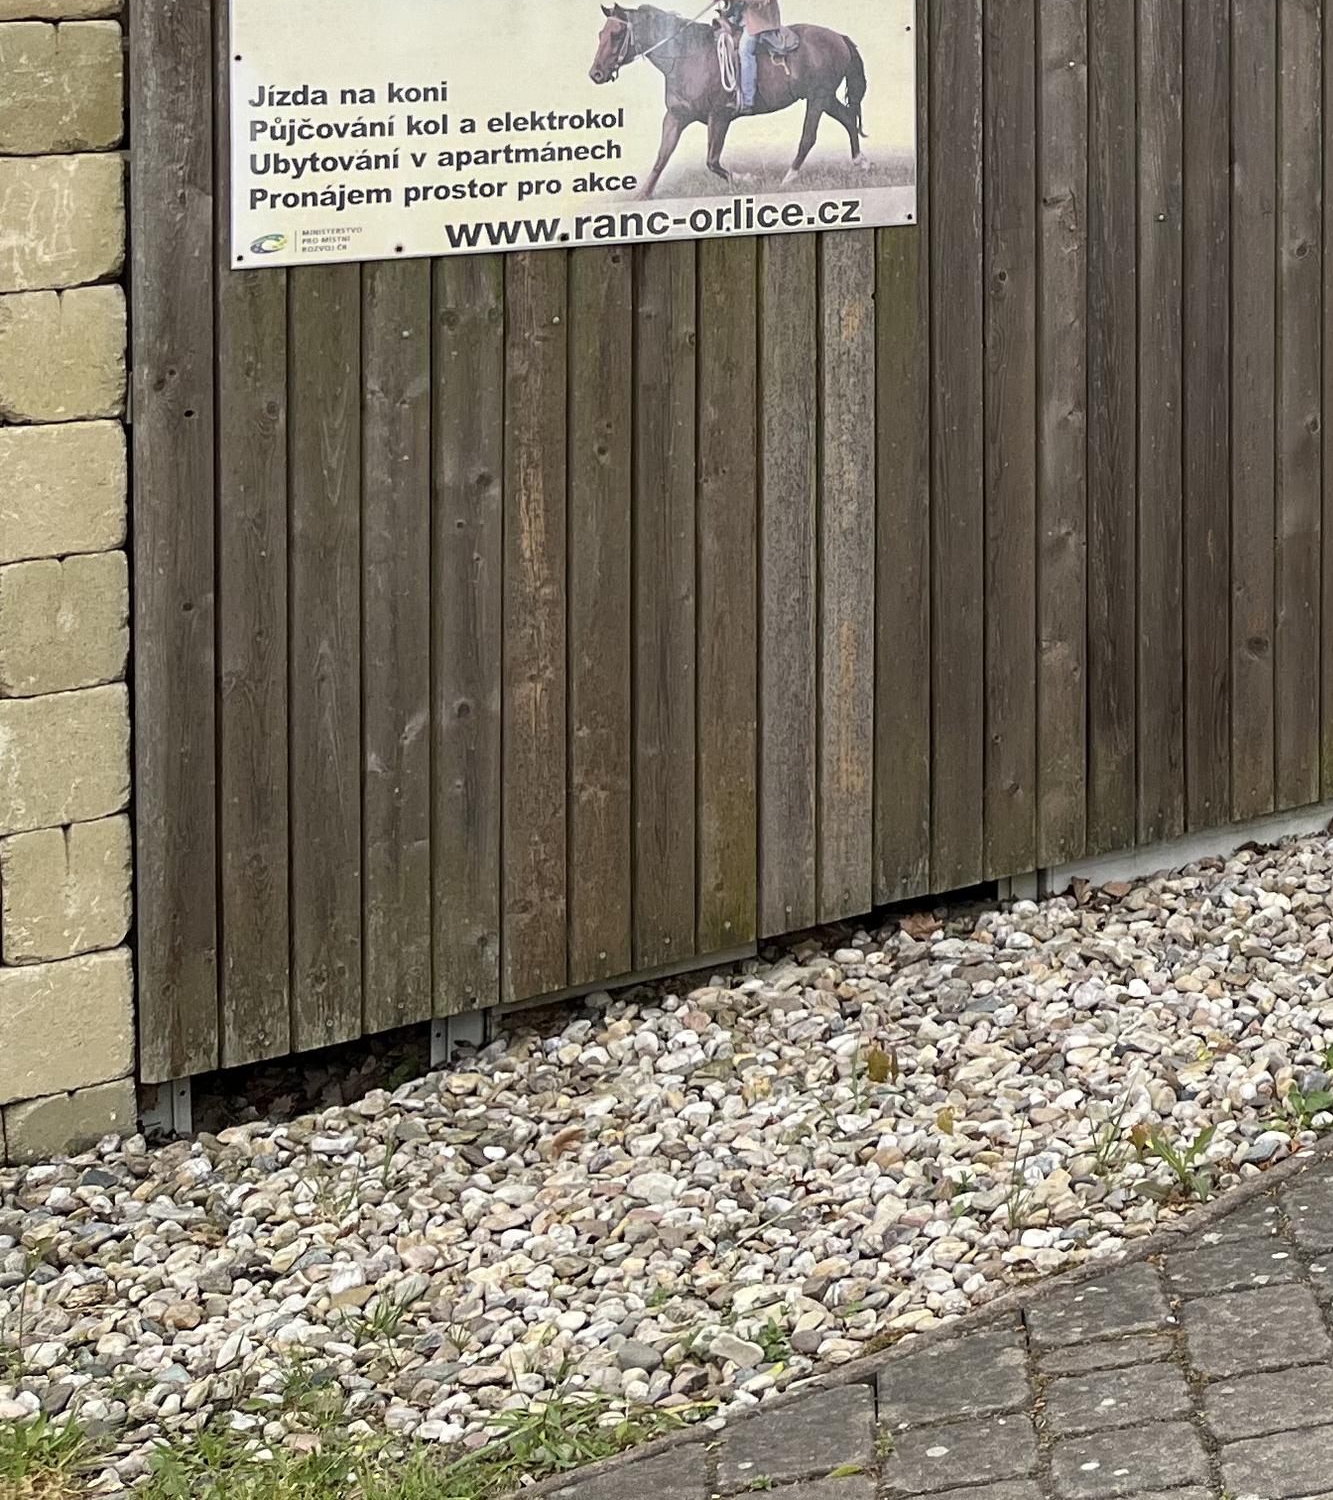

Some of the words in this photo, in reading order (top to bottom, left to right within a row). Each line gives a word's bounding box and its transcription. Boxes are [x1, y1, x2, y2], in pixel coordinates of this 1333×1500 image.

[248, 84, 329, 108] Jízda
[340, 88, 376, 105] na
[387, 80, 448, 104] koni
[250, 114, 396, 147] Půjčování
[406, 113, 449, 136] kol
[459, 117, 477, 134] a
[486, 107, 625, 133] elektrokol
[250, 146, 401, 180] Ubytování
[410, 151, 428, 168] v
[436, 139, 622, 172] apartmánech
[250, 183, 393, 212] Pronájem
[403, 178, 508, 208] prostor
[517, 178, 563, 202] pro
[571, 171, 638, 194] akce
[444, 197, 863, 249] www.ranc-orlice.cz
